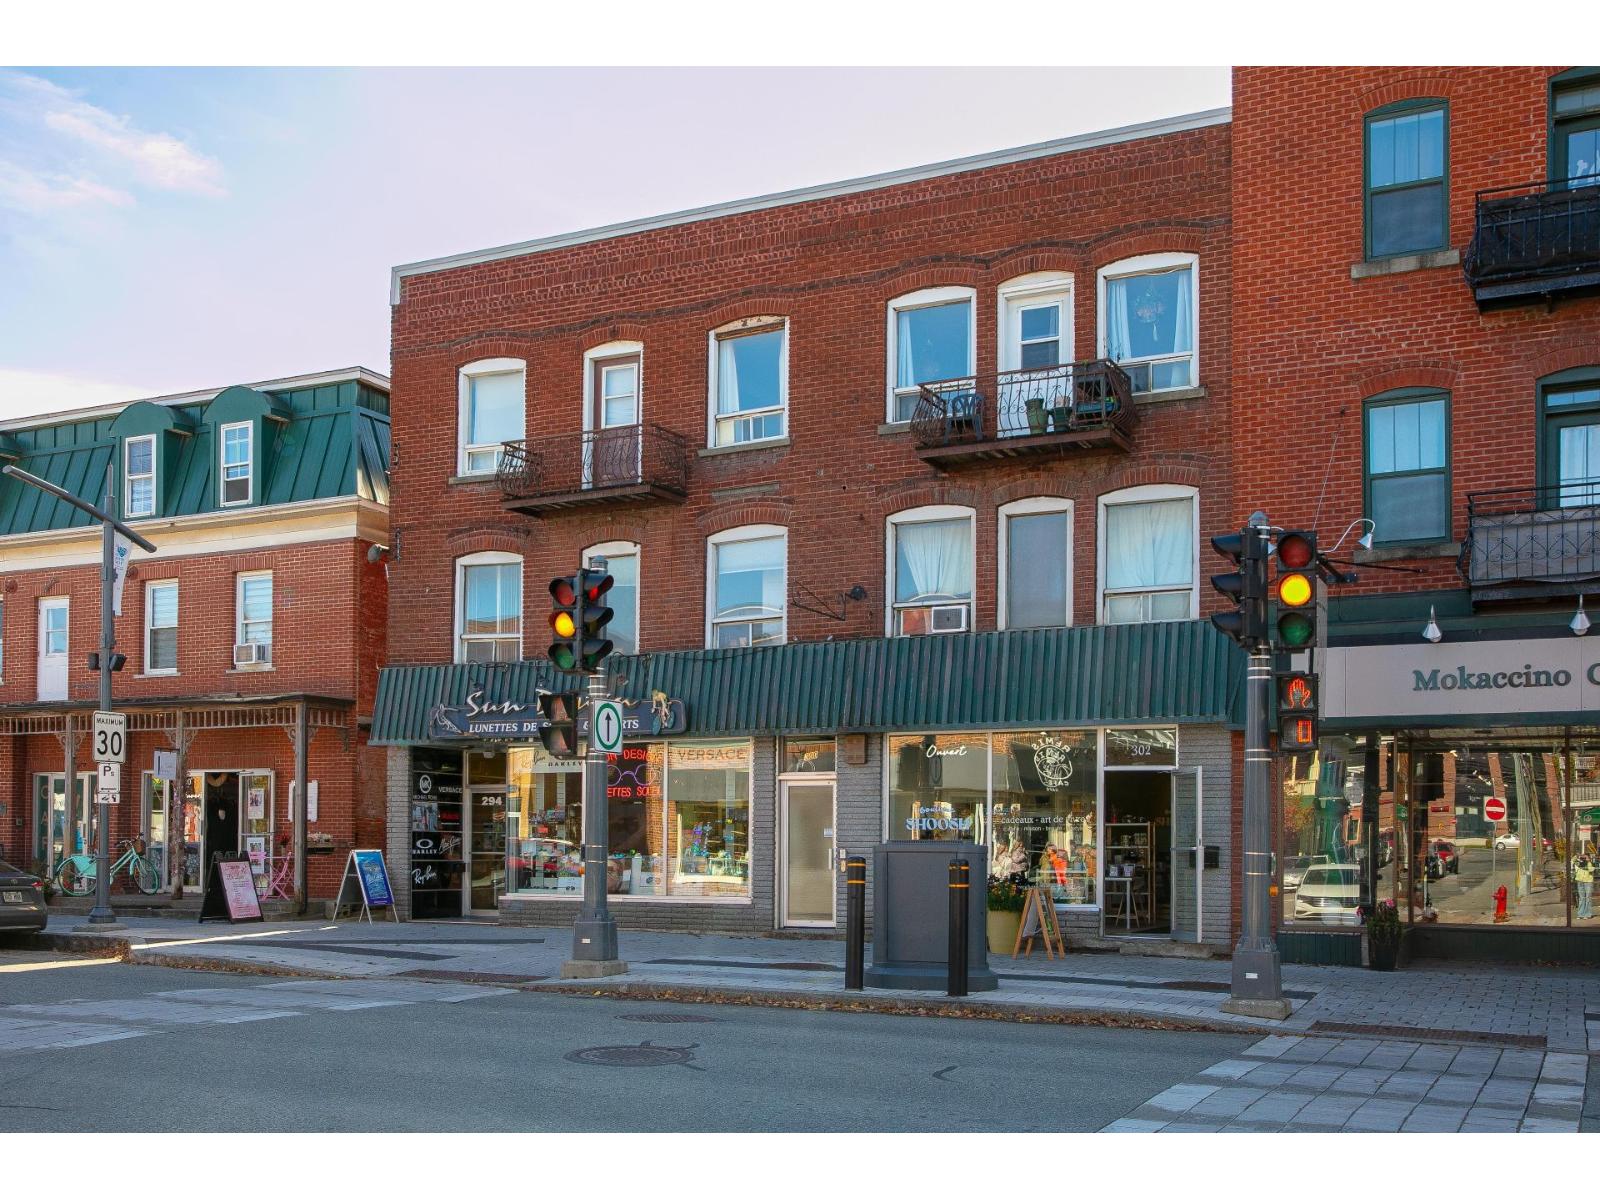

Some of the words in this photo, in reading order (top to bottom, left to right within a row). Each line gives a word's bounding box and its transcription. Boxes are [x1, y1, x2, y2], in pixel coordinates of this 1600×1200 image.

[1412, 664, 1572, 691] Mokaccino
[466, 690, 526, 717] Sun
[96, 717, 124, 727] MAXIMUM
[469, 723, 518, 733] LUNETTES
[523, 722, 537, 732] DE
[97, 730, 122, 756] 30
[678, 749, 747, 761] VERSACE
[926, 744, 967, 758] Ouvert
[1131, 744, 1152, 756] 302
[481, 796, 503, 806] 294
[1001, 815, 1034, 824] cadeaux
[1041, 816, 1051, 824] art
[1053, 815, 1063, 823] de
